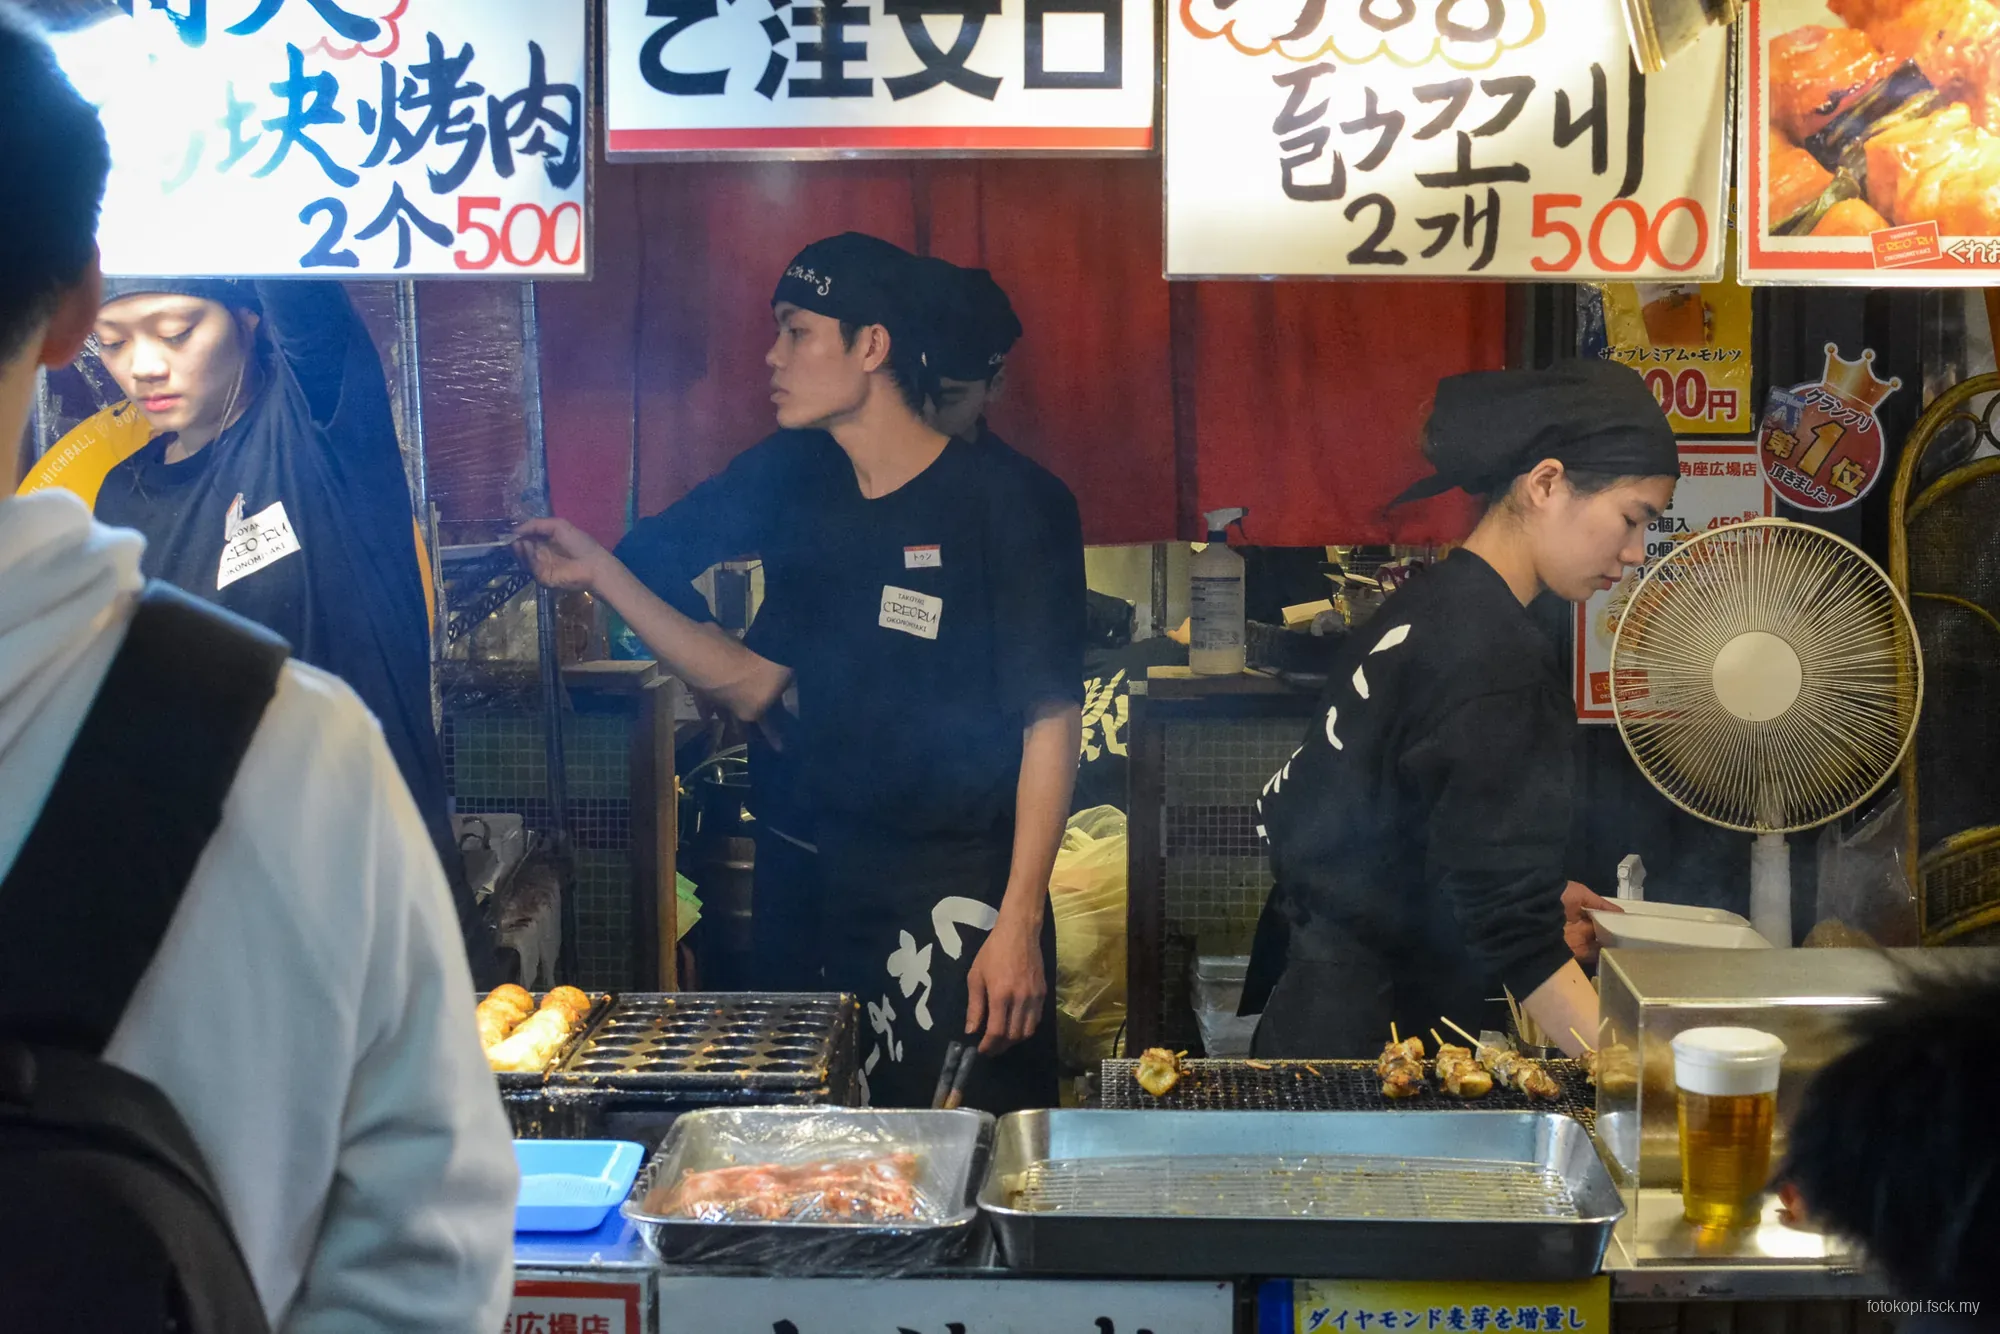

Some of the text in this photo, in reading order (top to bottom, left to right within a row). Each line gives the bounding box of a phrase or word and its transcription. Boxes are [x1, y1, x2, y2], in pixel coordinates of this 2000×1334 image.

[158, 31, 582, 194] 块烤肉
[1530, 194, 1708, 271] 500
[1633, 368, 1737, 420] 00円
[1806, 389, 1873, 432] グランプリ
[1308, 1306, 1585, 1330] ダイヤモンド麦芽を増量し
